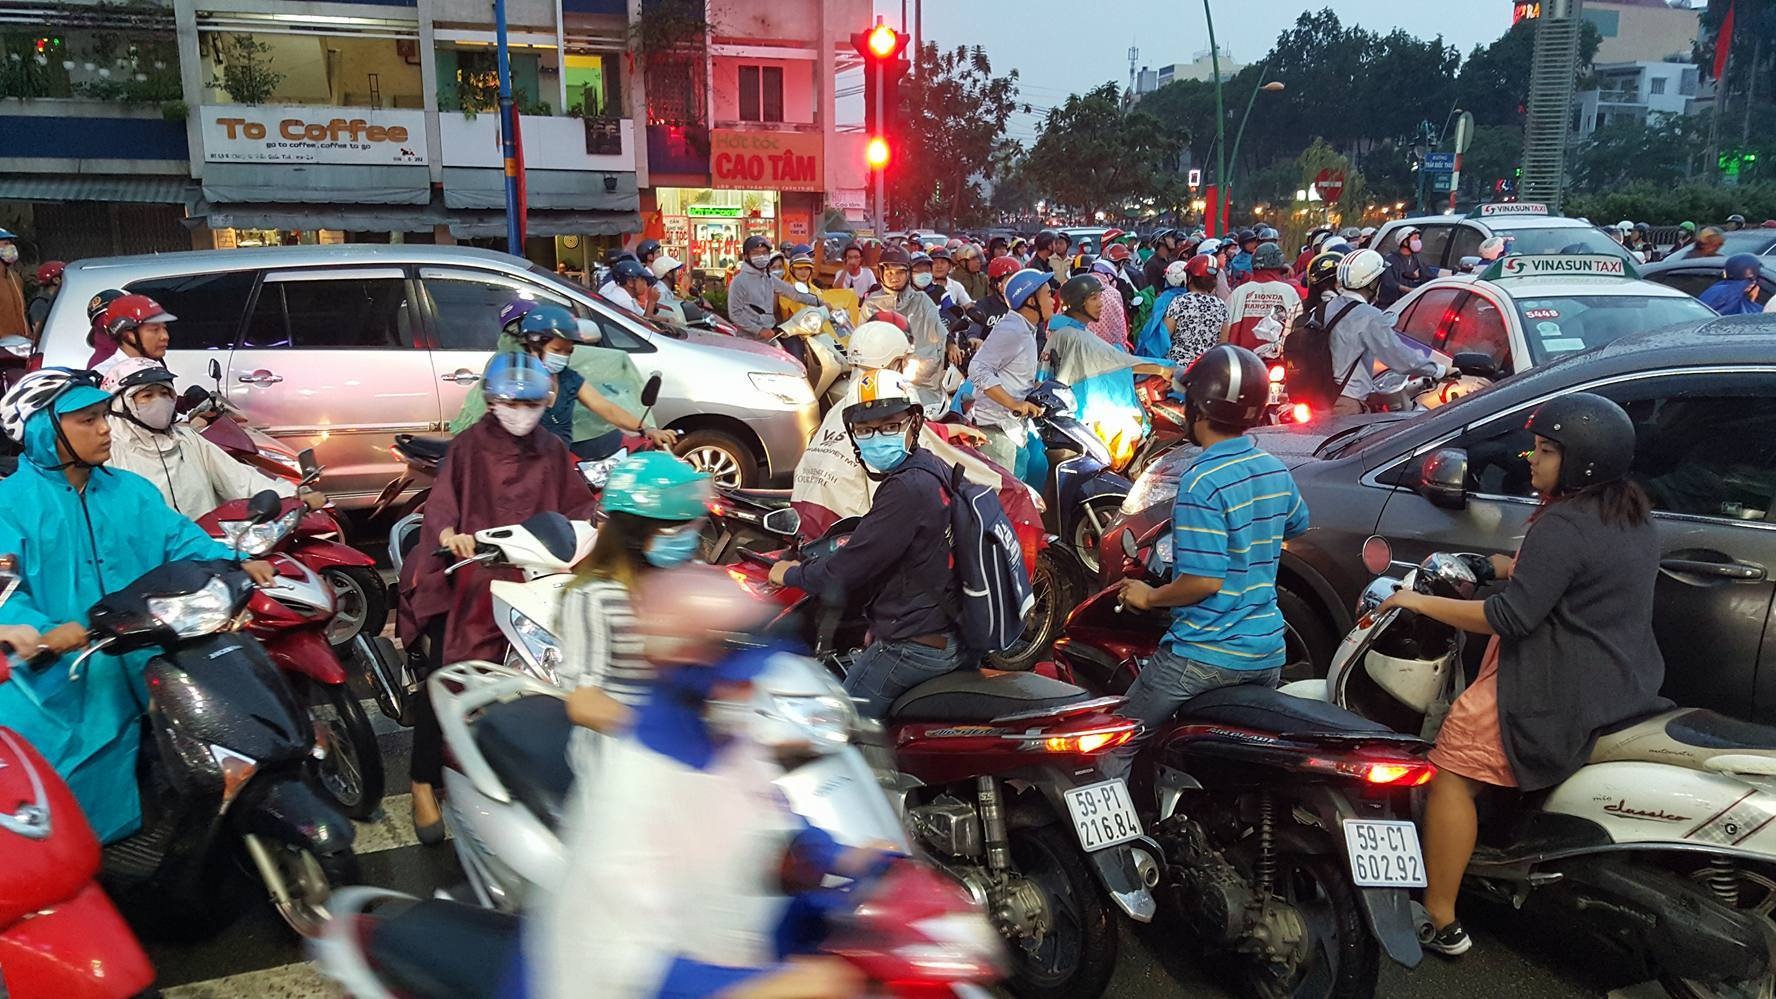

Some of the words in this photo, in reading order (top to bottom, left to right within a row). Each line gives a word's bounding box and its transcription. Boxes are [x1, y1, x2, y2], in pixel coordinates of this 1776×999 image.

[216, 117, 267, 140] To
[279, 118, 409, 143] Coffee
[716, 152, 764, 181] CAO
[768, 149, 816, 181] TÂM
[1497, 205, 1530, 213] VINASUN
[1532, 260, 1592, 271] VINASUN
[1594, 261, 1622, 273] TAXI
[1254, 293, 1283, 301] HONDA
[1075, 785, 1122, 817] 59-P1
[1604, 799, 1692, 821] classico
[1080, 810, 1137, 847] 216.84
[1356, 825, 1406, 852] 59-C1
[1356, 854, 1421, 881] 602.92
